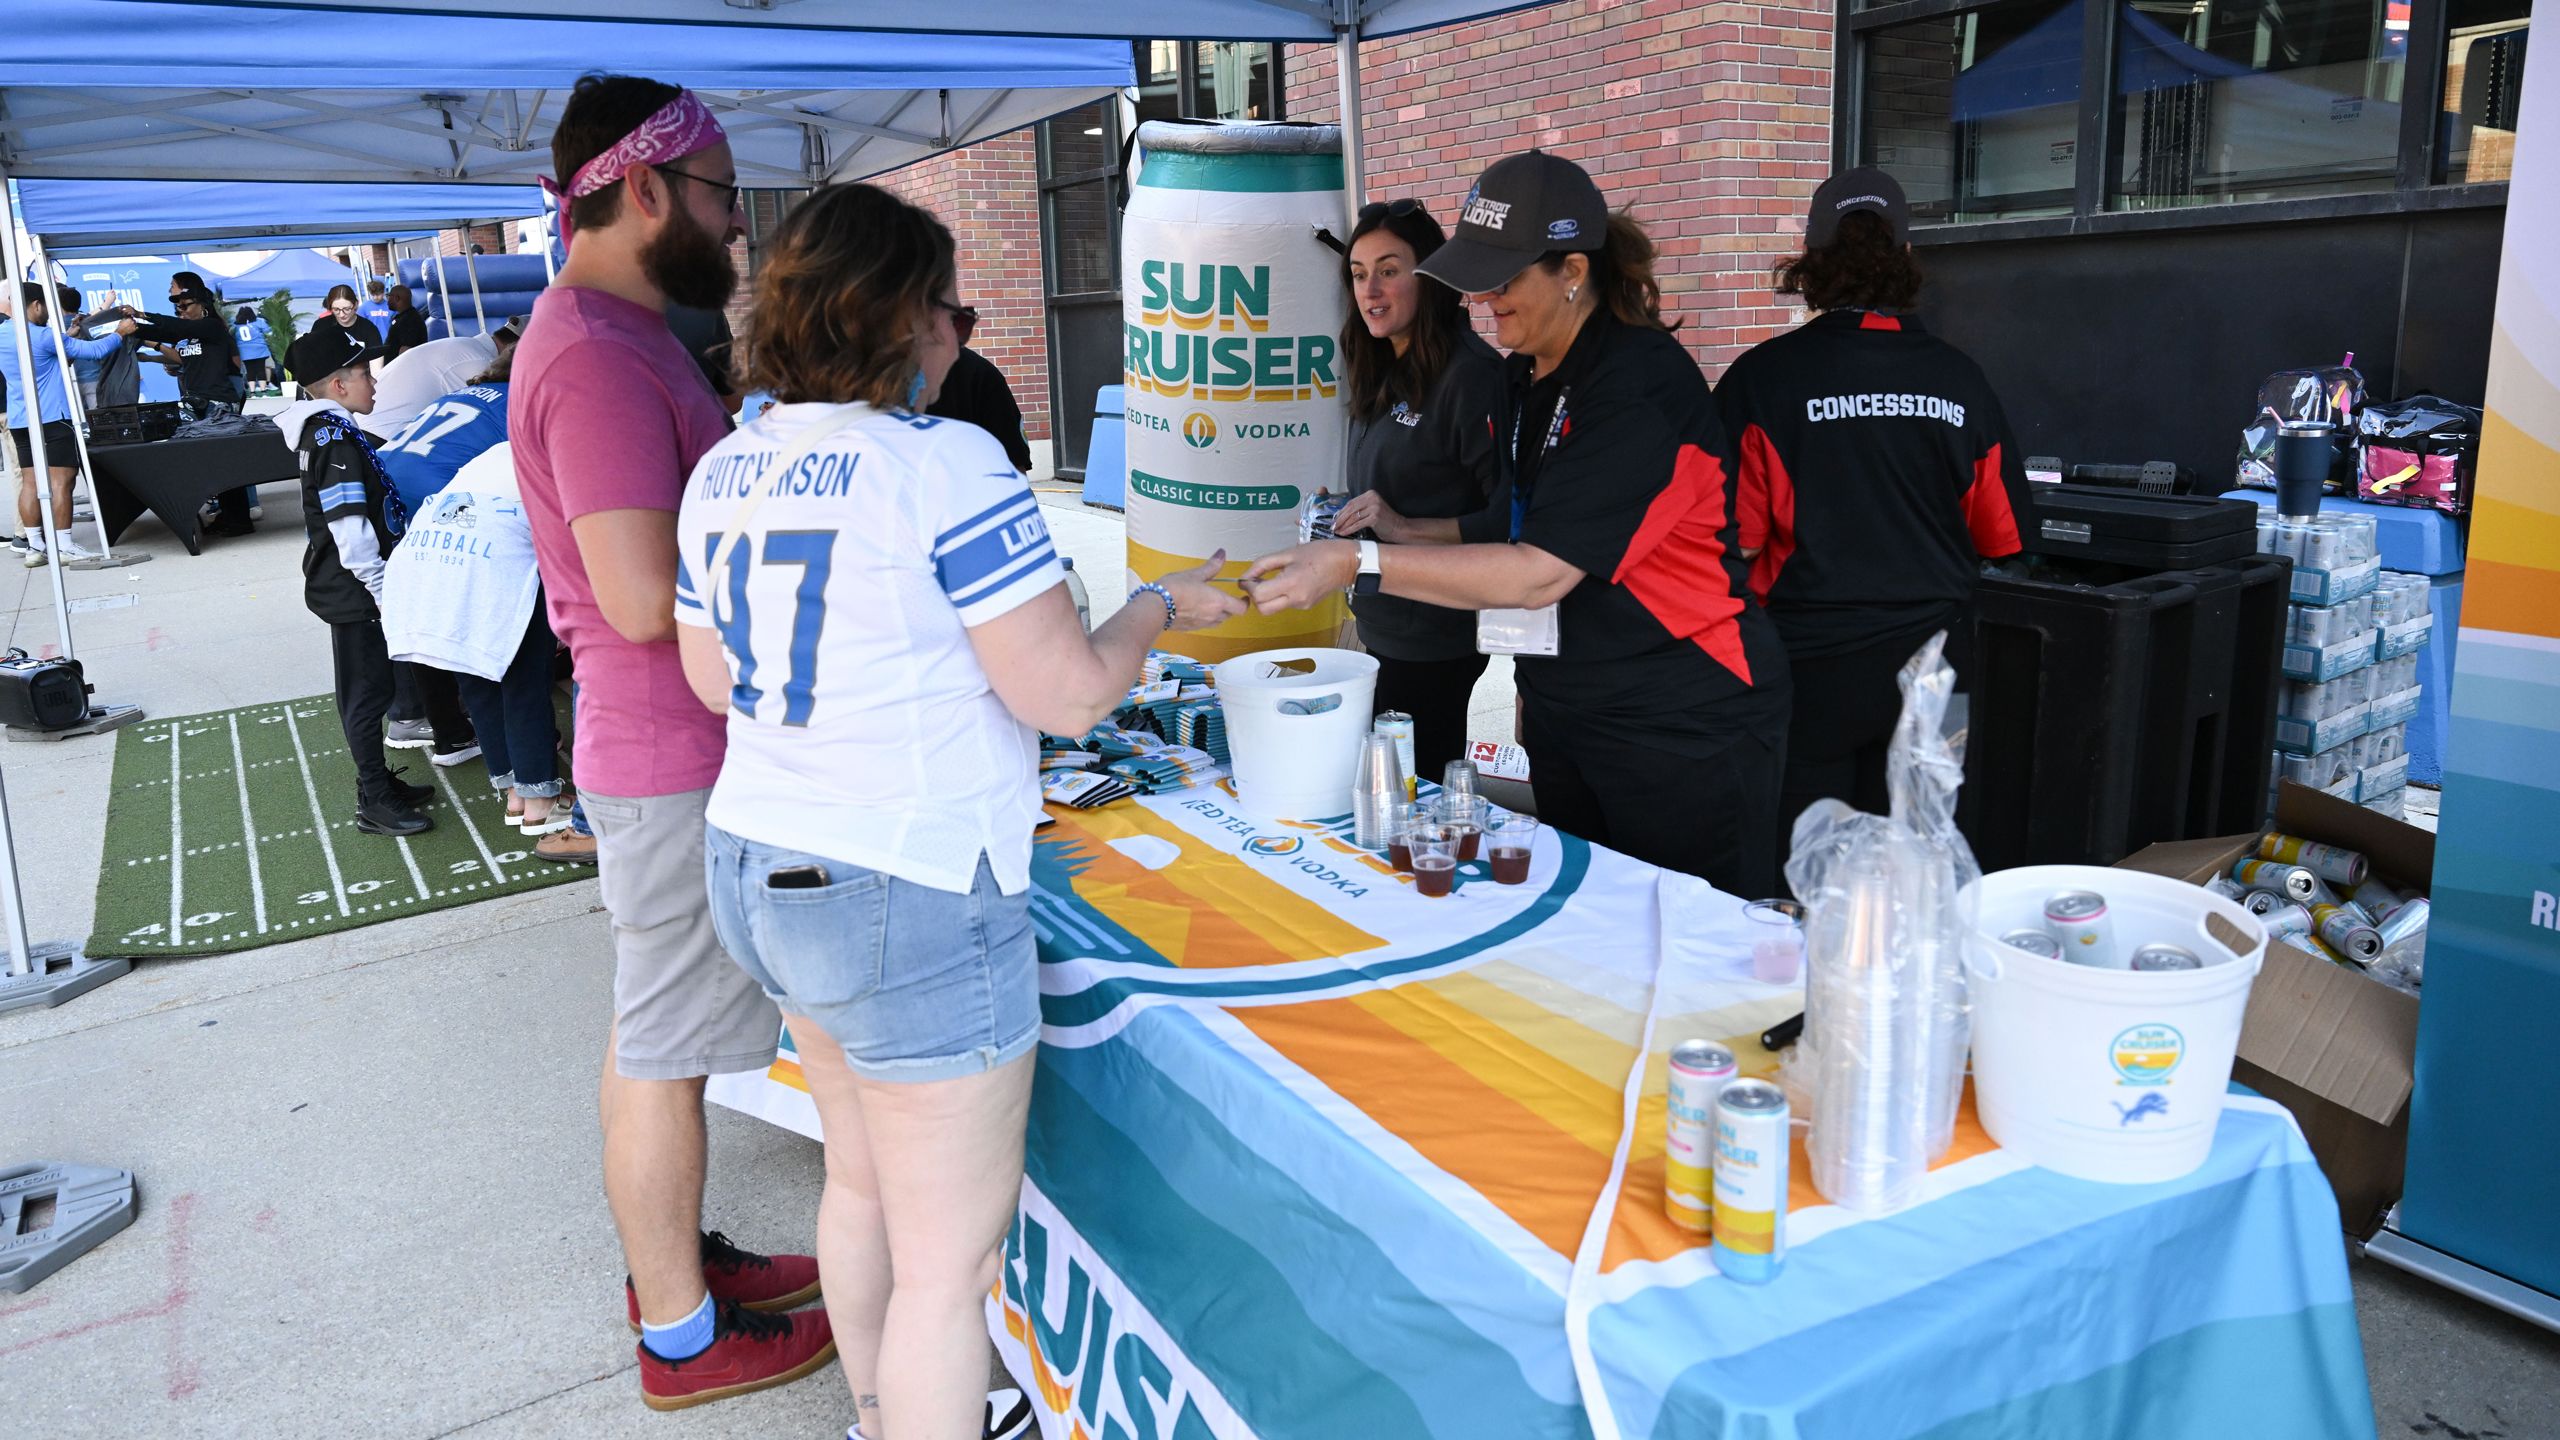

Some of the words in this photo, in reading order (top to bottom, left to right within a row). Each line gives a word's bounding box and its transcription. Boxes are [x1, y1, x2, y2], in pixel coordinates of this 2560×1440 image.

[1476, 197, 1512, 213] DETROIT
[1836, 195, 1888, 210] CONCESSIONS
[1463, 204, 1507, 230] LIONS
[1141, 259, 1270, 318] SUN
[239, 325, 251, 342] 0
[1806, 393, 1966, 428] CONCESSIONS
[315, 425, 344, 446] 97
[1144, 413, 1171, 433] TEA
[1234, 422, 1311, 439] VODKA
[1140, 479, 1193, 502] CLASSIC
[1199, 490, 1240, 505] ICED
[1246, 492, 1281, 505] TEA
[403, 529, 492, 559] FOOTBALL
[1222, 815, 1257, 837] TEA
[1289, 856, 1369, 898] VODKA
